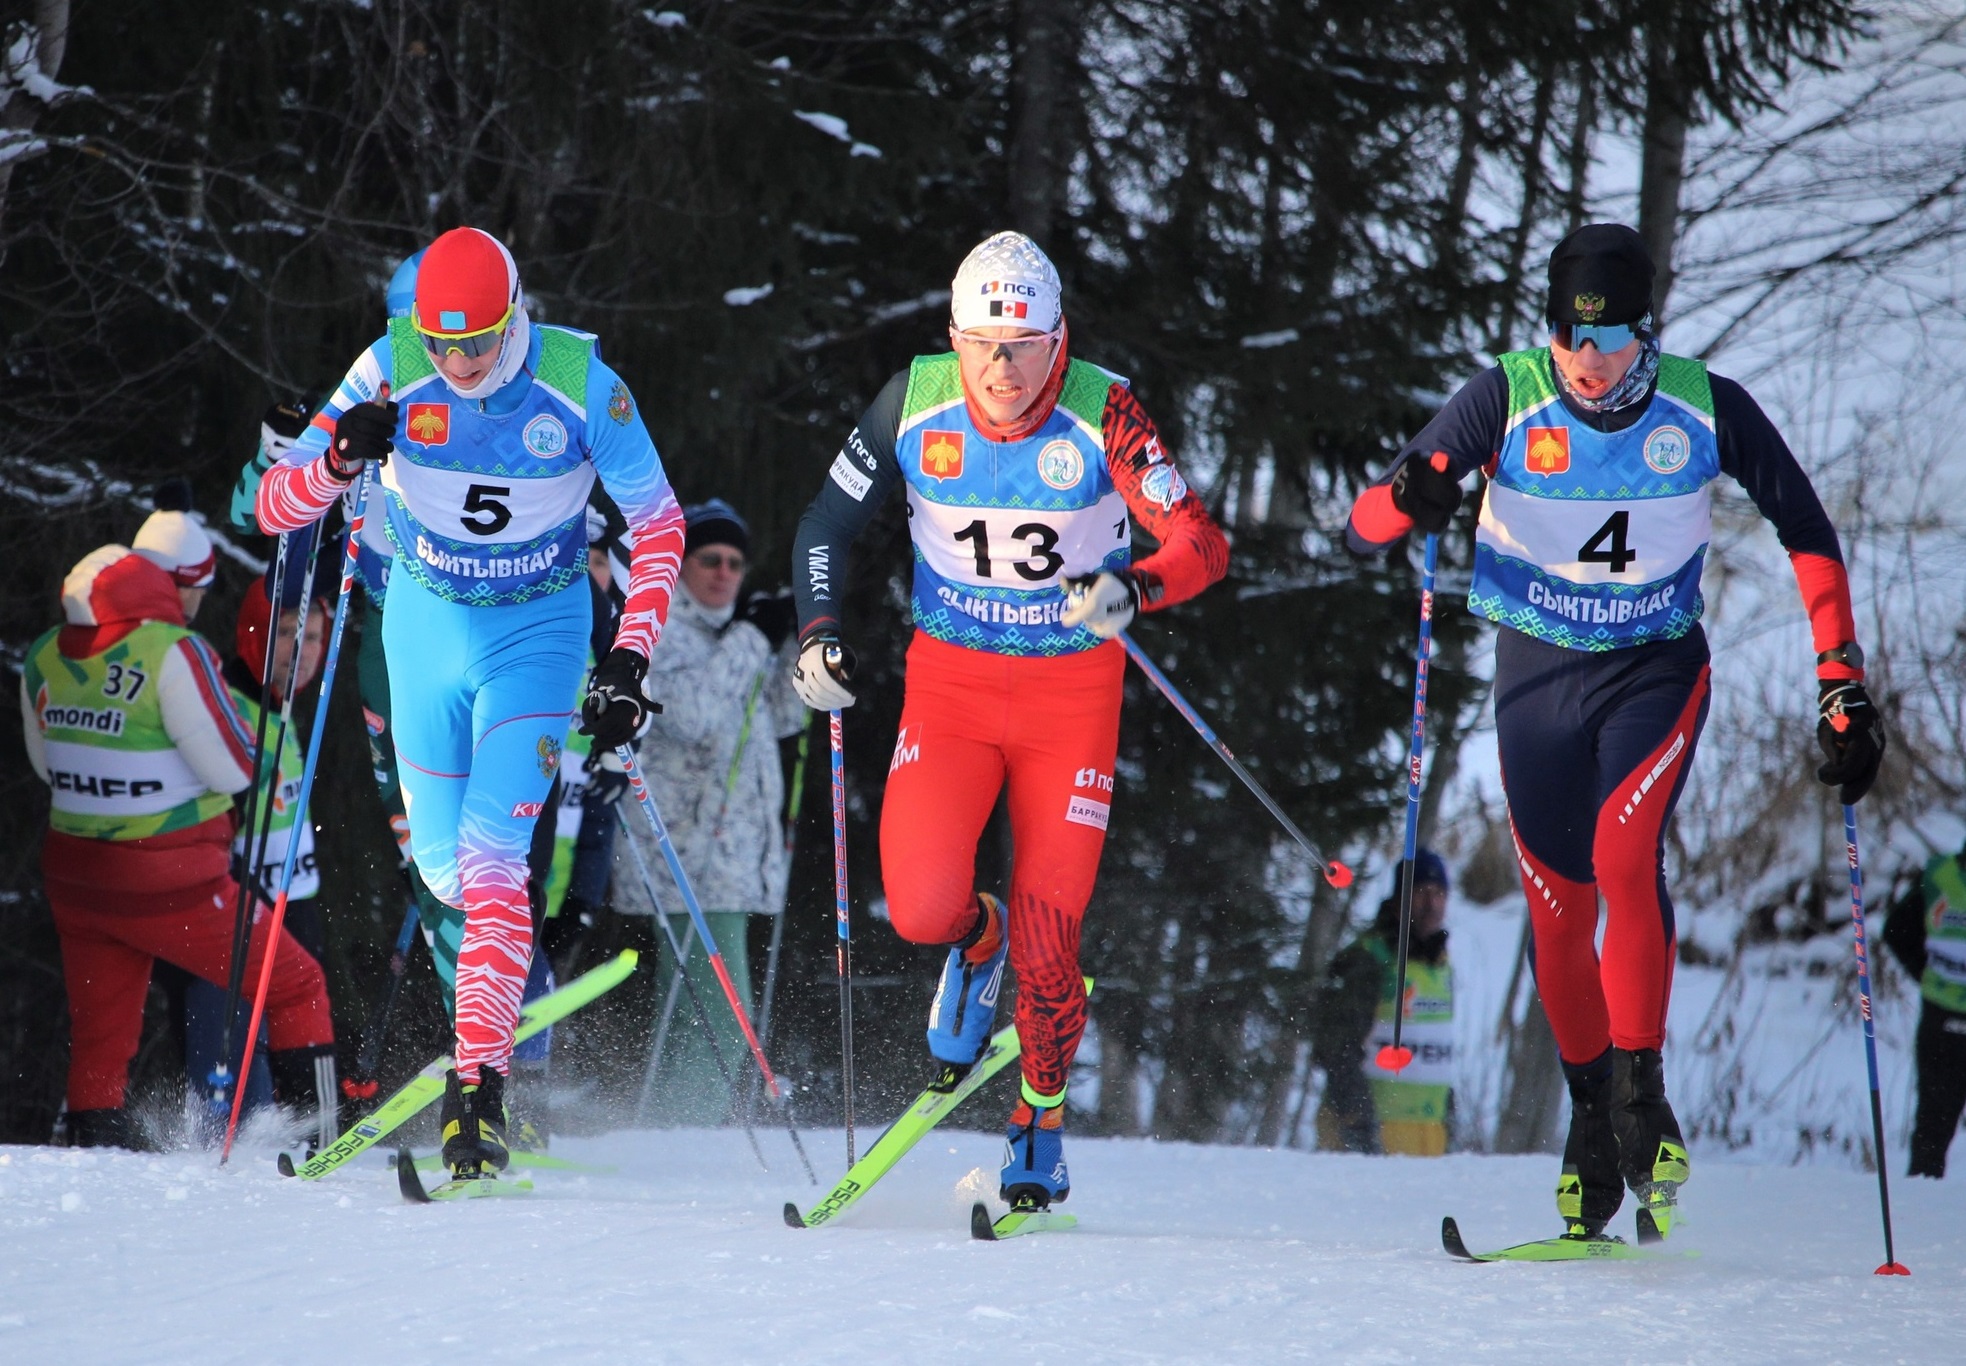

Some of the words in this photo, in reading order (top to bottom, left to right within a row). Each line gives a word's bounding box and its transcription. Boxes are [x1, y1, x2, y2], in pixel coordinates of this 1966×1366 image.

[1003, 283, 1037, 298] ПСБ
[460, 483, 513, 536] 5
[415, 534, 560, 579] СЫКТЫВКАР
[953, 519, 1066, 582] 13
[1577, 510, 1636, 573] 4
[808, 545, 830, 593] VMAX
[1528, 581, 1676, 625] СЫКТЫВКАР
[103, 664, 146, 701] 37
[45, 708, 122, 734] mondi
[511, 803, 543, 818] KV
[297, 1133, 366, 1178] FISCHER
[804, 1179, 861, 1226] FISCHER
